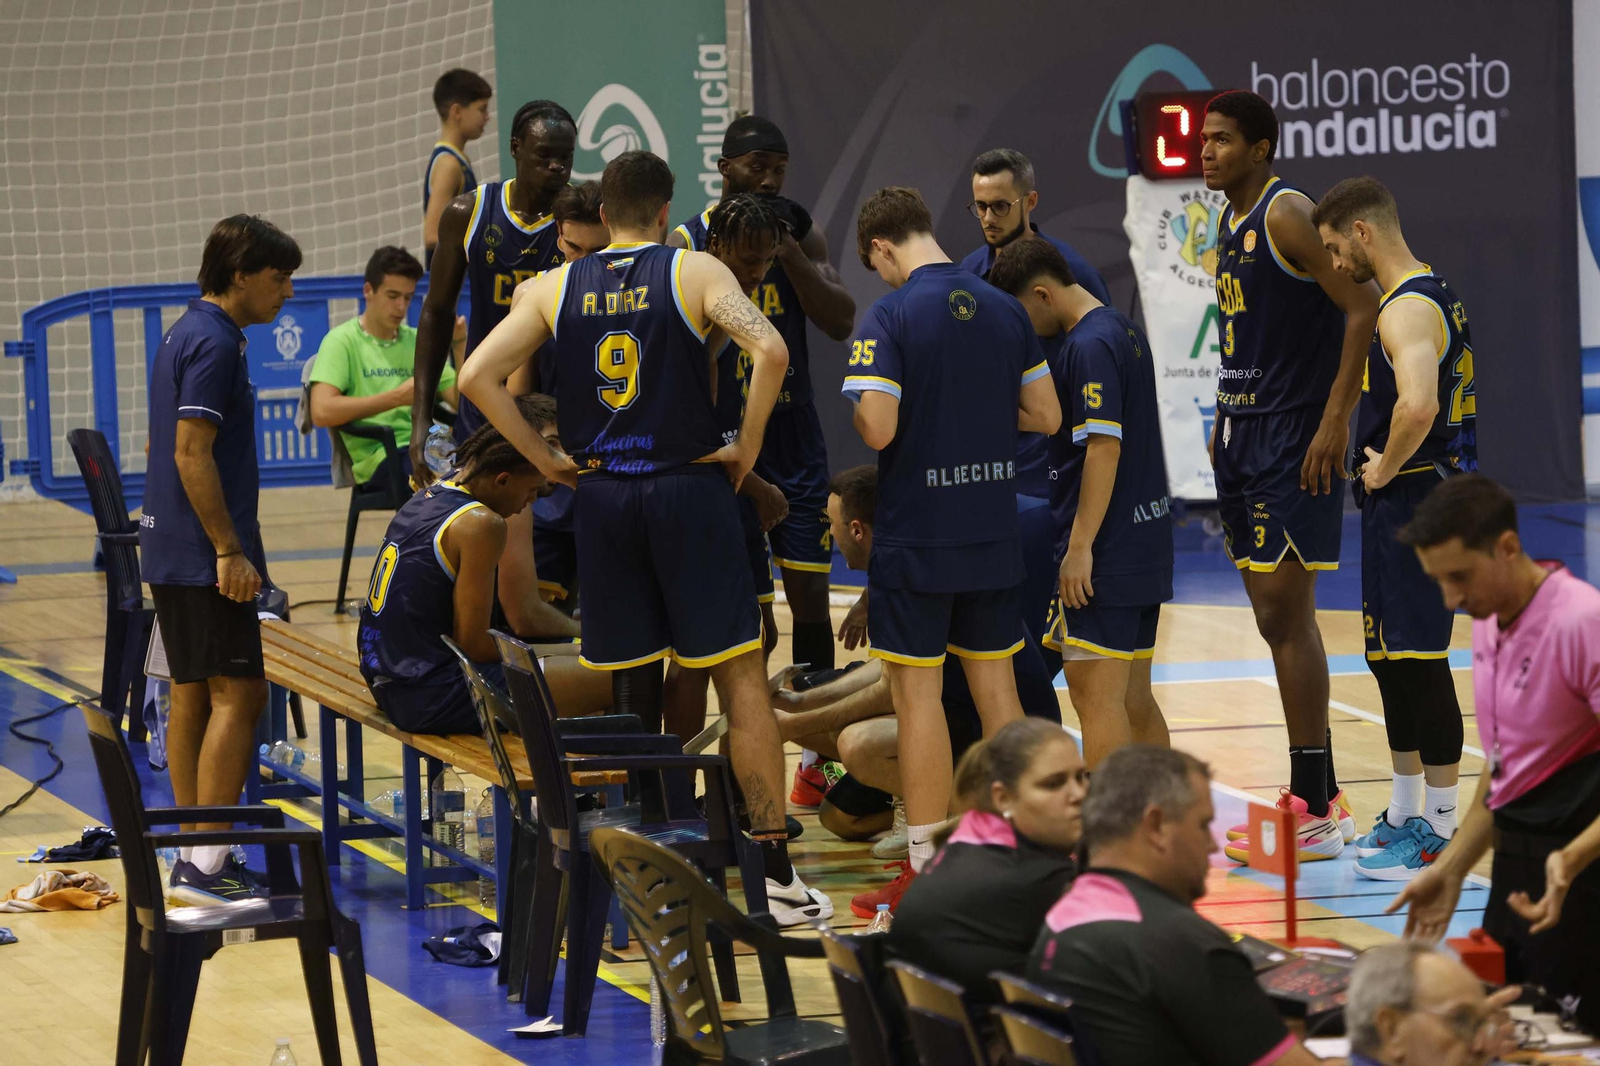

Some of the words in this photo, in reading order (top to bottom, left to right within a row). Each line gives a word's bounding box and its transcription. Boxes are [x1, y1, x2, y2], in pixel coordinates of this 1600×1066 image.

[1251, 52, 1511, 110] baloncesto
[1158, 208, 1173, 251] CLUB
[1169, 262, 1216, 289] ALGEC
[1216, 272, 1247, 316] CBA
[848, 339, 877, 367] 35
[1223, 319, 1235, 357] 3
[595, 330, 642, 412] 9
[1163, 366, 1196, 378] Junta
[1199, 366, 1211, 378] de
[1082, 382, 1103, 410] 15
[926, 460, 1016, 488] ALGECIRA
[1254, 525, 1266, 548] 3
[364, 541, 400, 617] 0
